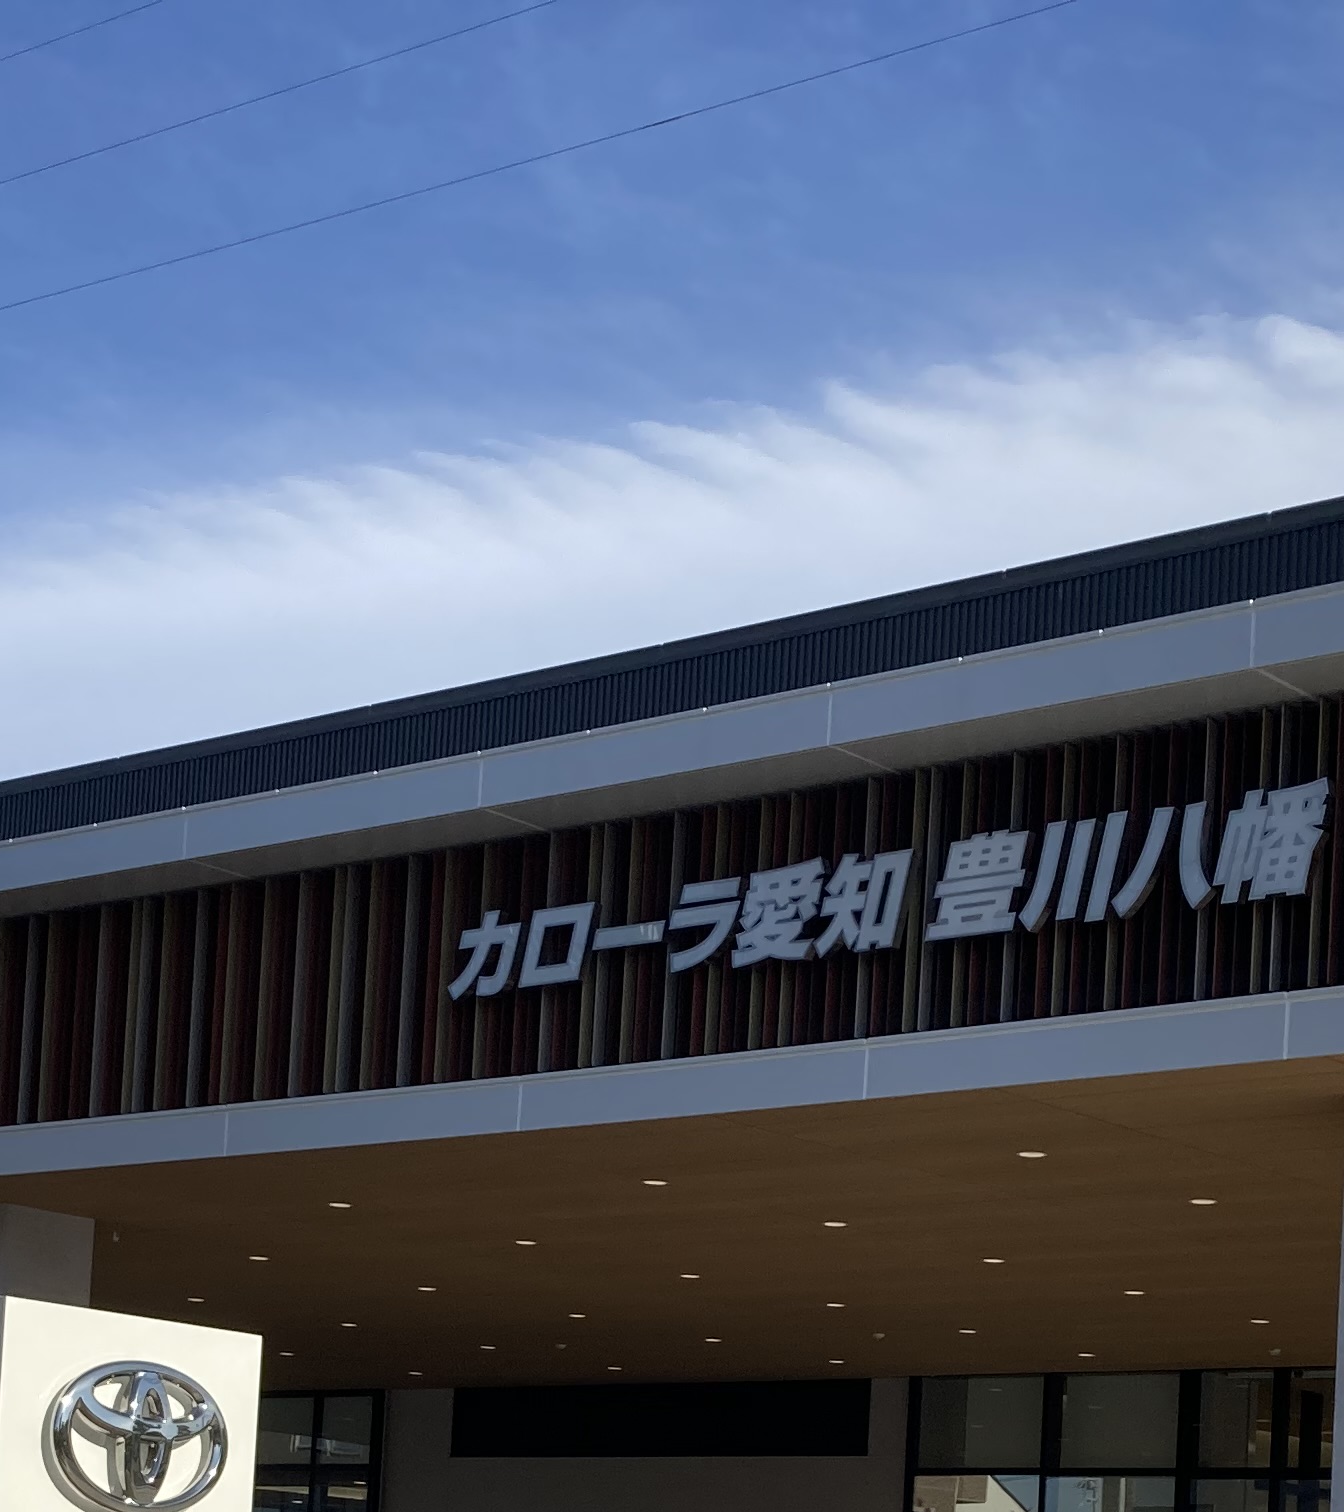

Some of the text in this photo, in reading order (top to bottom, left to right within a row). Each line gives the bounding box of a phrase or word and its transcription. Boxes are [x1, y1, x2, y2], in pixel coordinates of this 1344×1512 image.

[448, 777, 1333, 1000] カローラ愛知 豊川八幡
